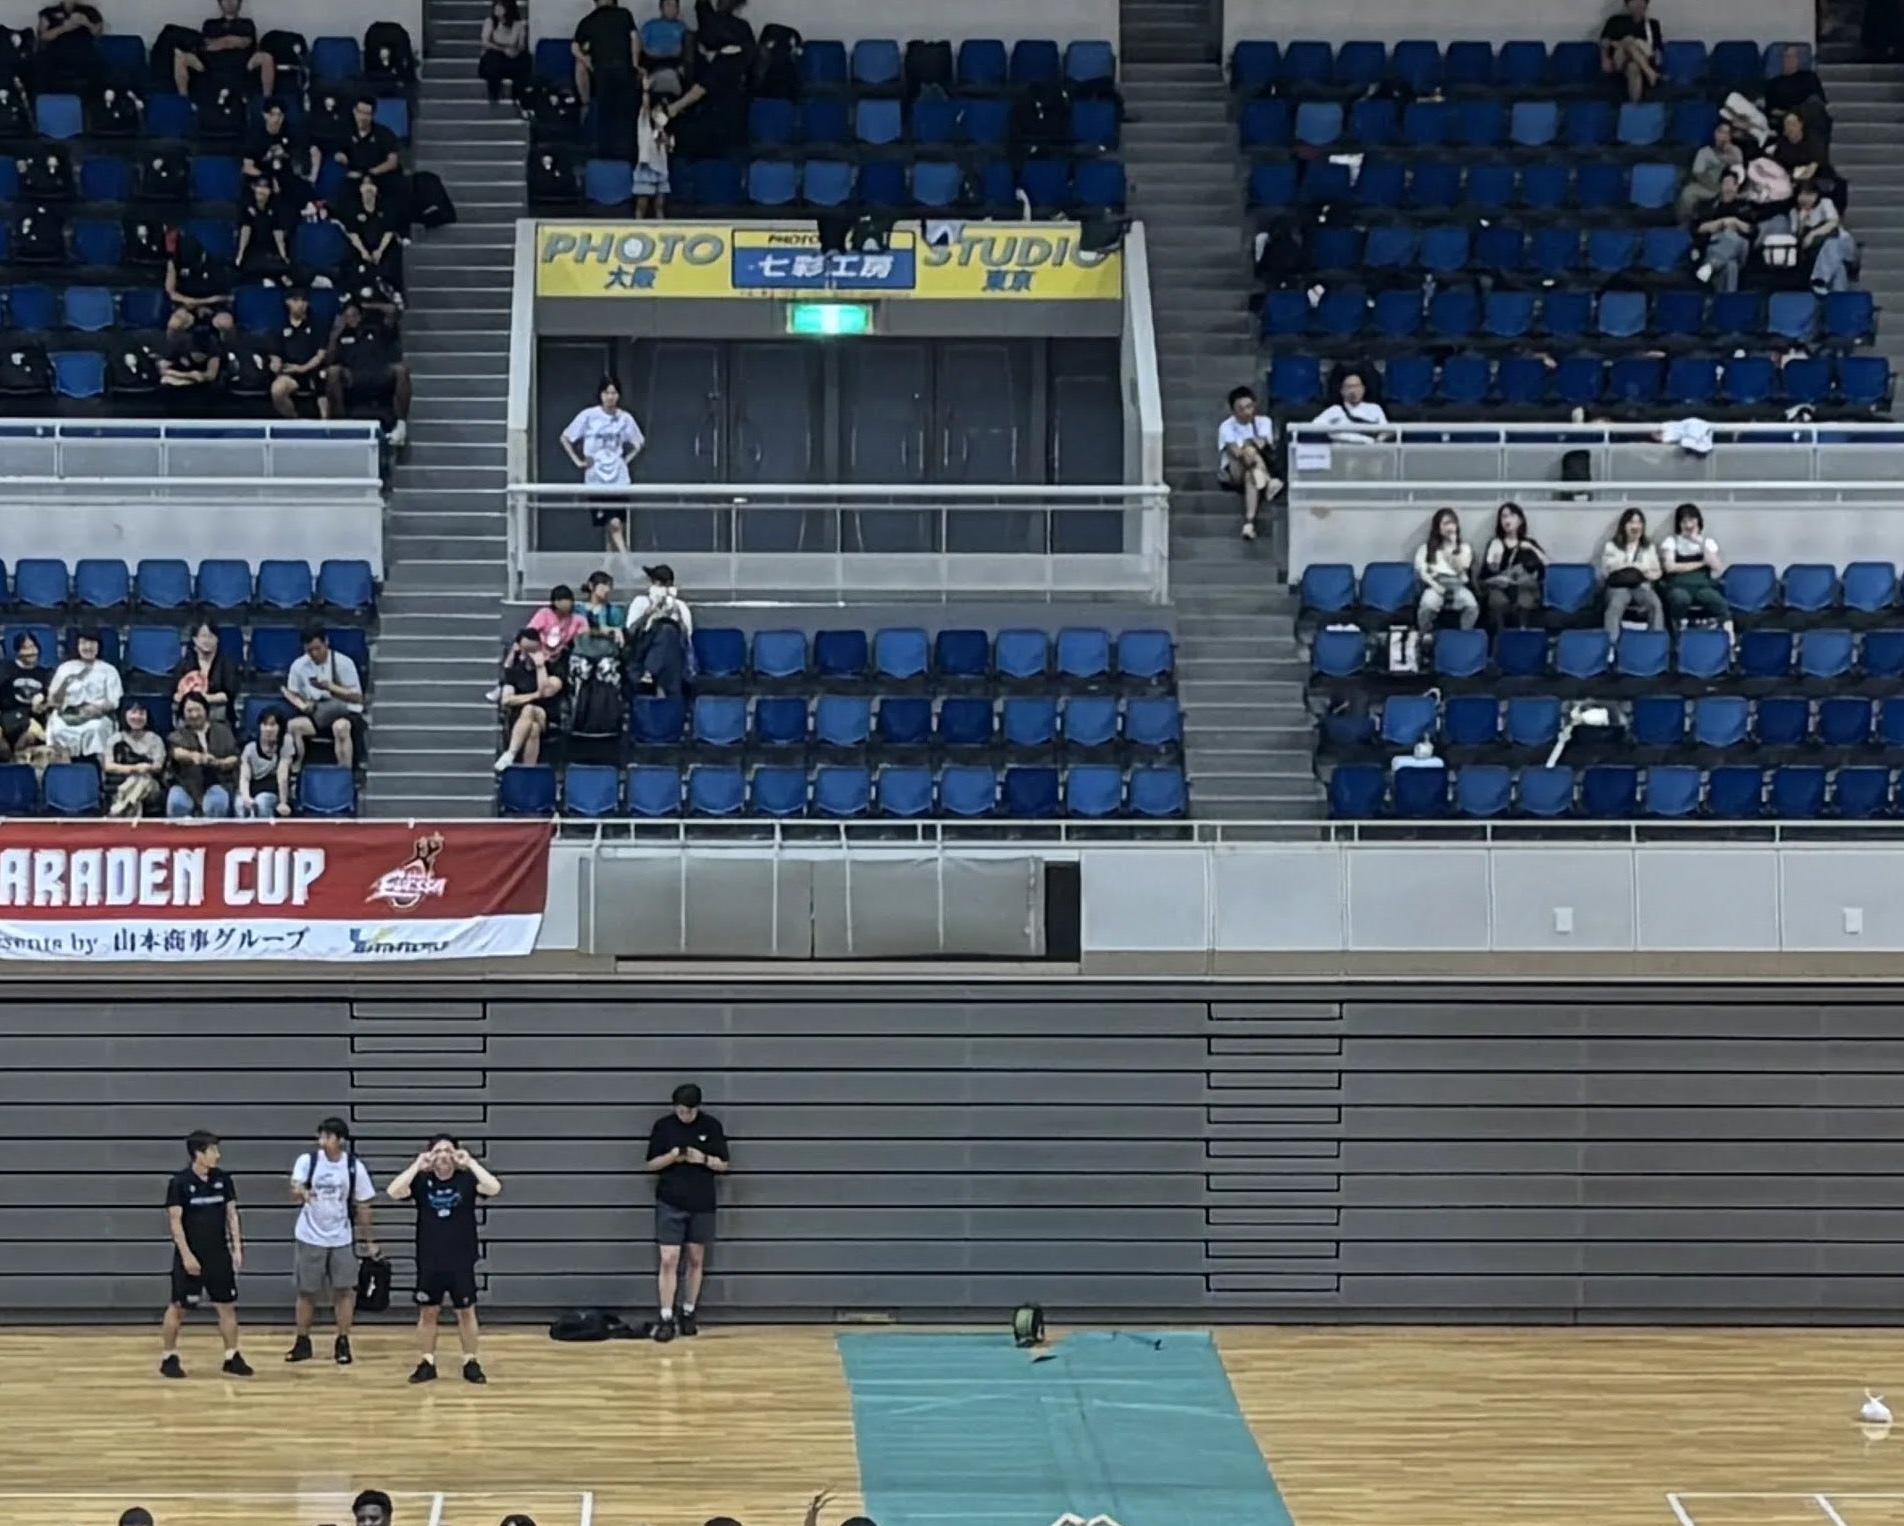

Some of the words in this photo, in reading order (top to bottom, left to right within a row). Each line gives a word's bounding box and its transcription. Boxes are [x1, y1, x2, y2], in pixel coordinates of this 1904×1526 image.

[541, 231, 725, 266] PHOTO
[224, 846, 327, 907] CUP
[113, 926, 309, 953] 山本商事グループ
